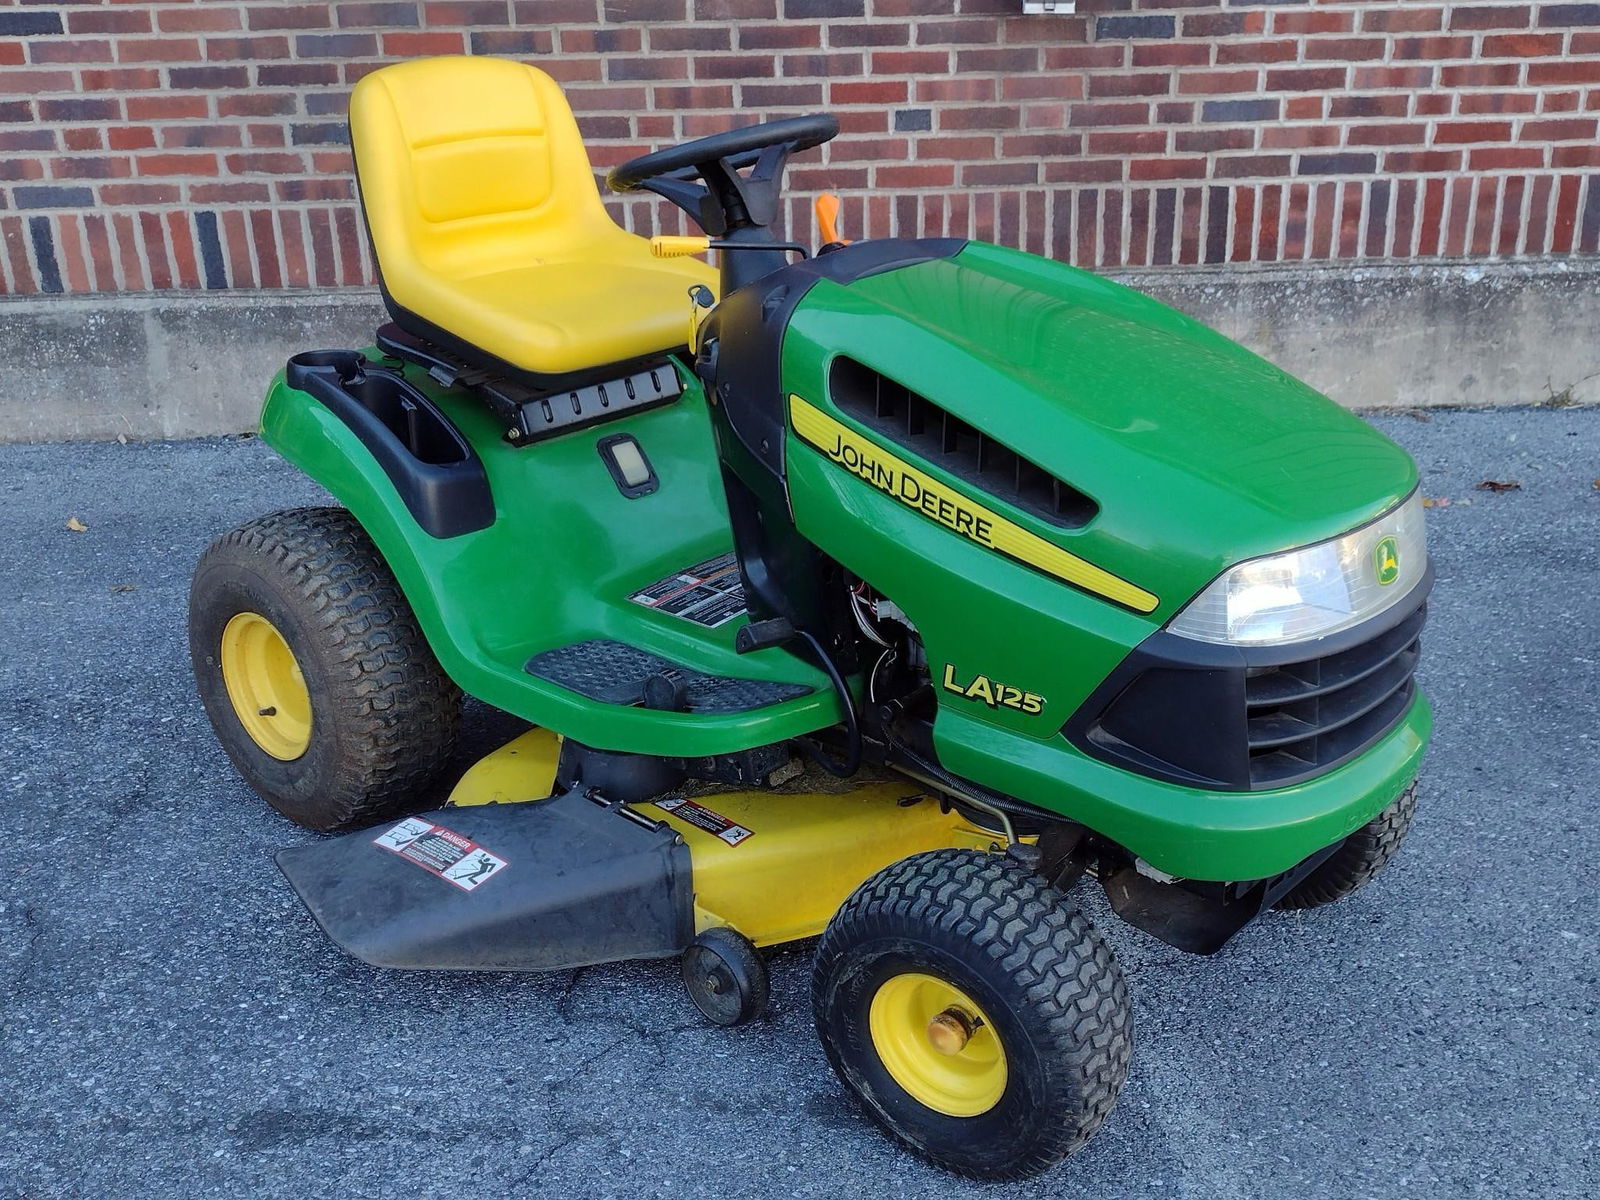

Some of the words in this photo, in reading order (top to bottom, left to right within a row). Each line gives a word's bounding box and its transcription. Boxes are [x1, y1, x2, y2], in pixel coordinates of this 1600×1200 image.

[829, 434, 894, 491] JOHN
[901, 472, 992, 544] DEERE
[943, 663, 1042, 714] LA125
[440, 831, 471, 850] DANGER
